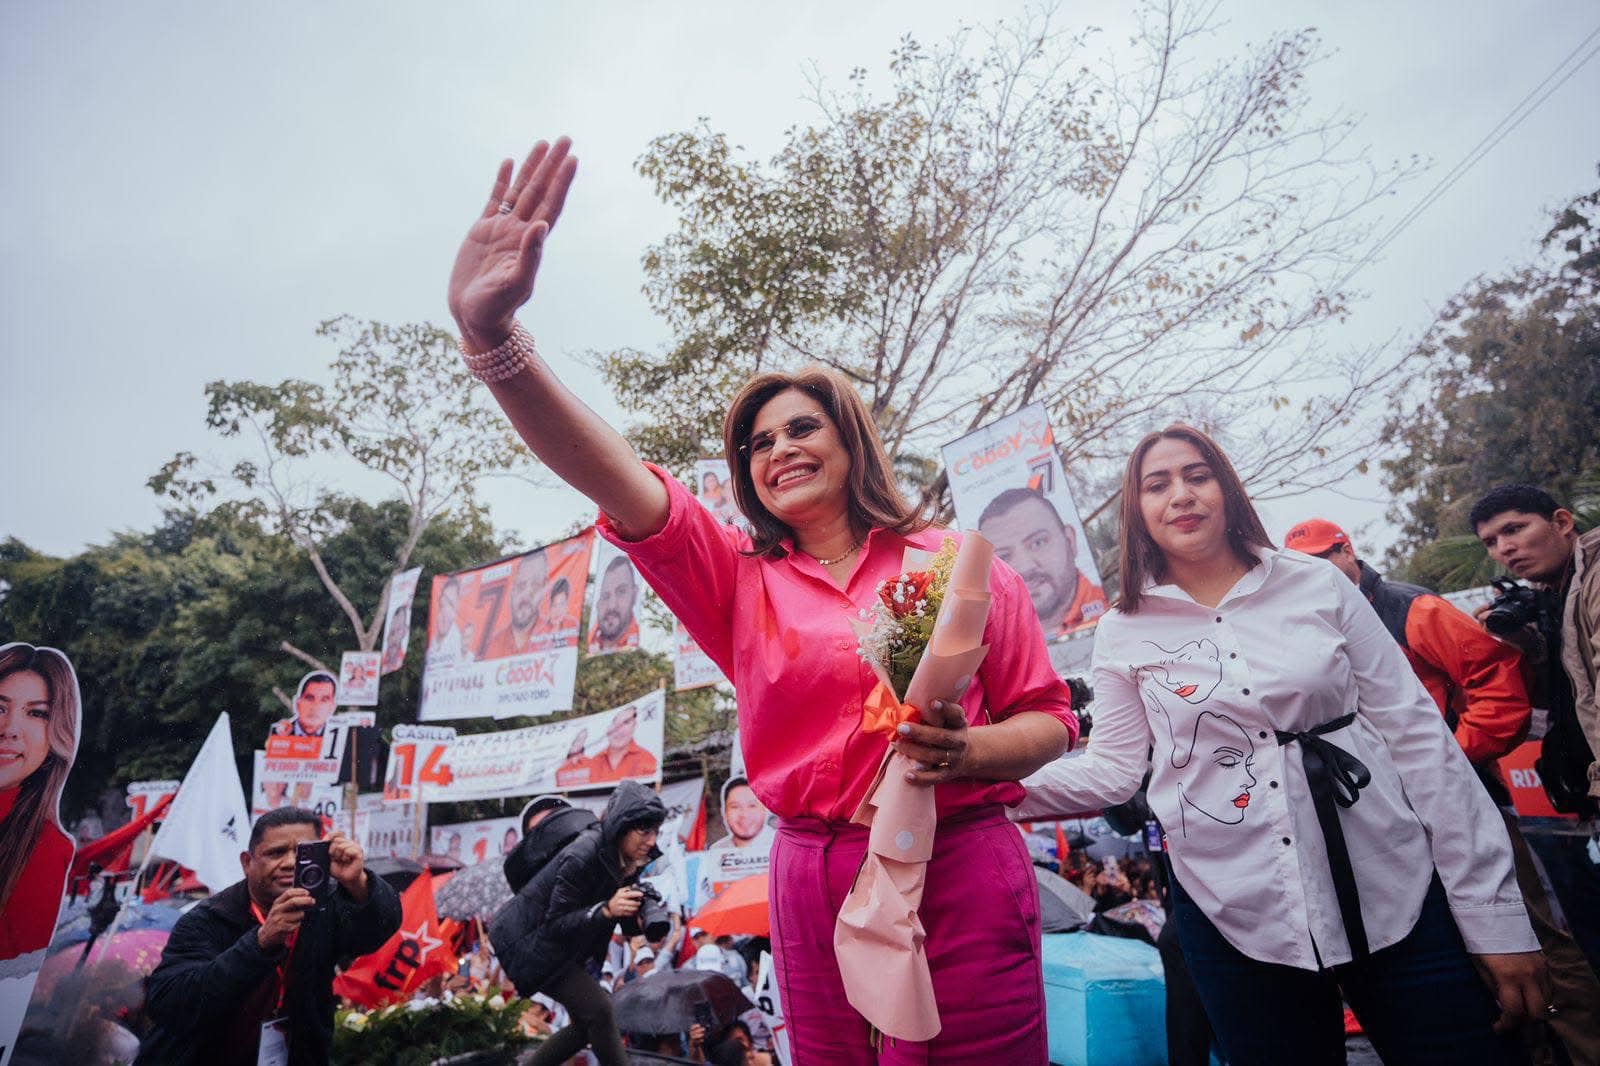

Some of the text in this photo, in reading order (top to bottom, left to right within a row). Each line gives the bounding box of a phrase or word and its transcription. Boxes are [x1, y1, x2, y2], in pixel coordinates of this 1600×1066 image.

[324, 727, 340, 760] 1
[395, 727, 455, 741] CASILLA
[394, 743, 454, 787] 14
